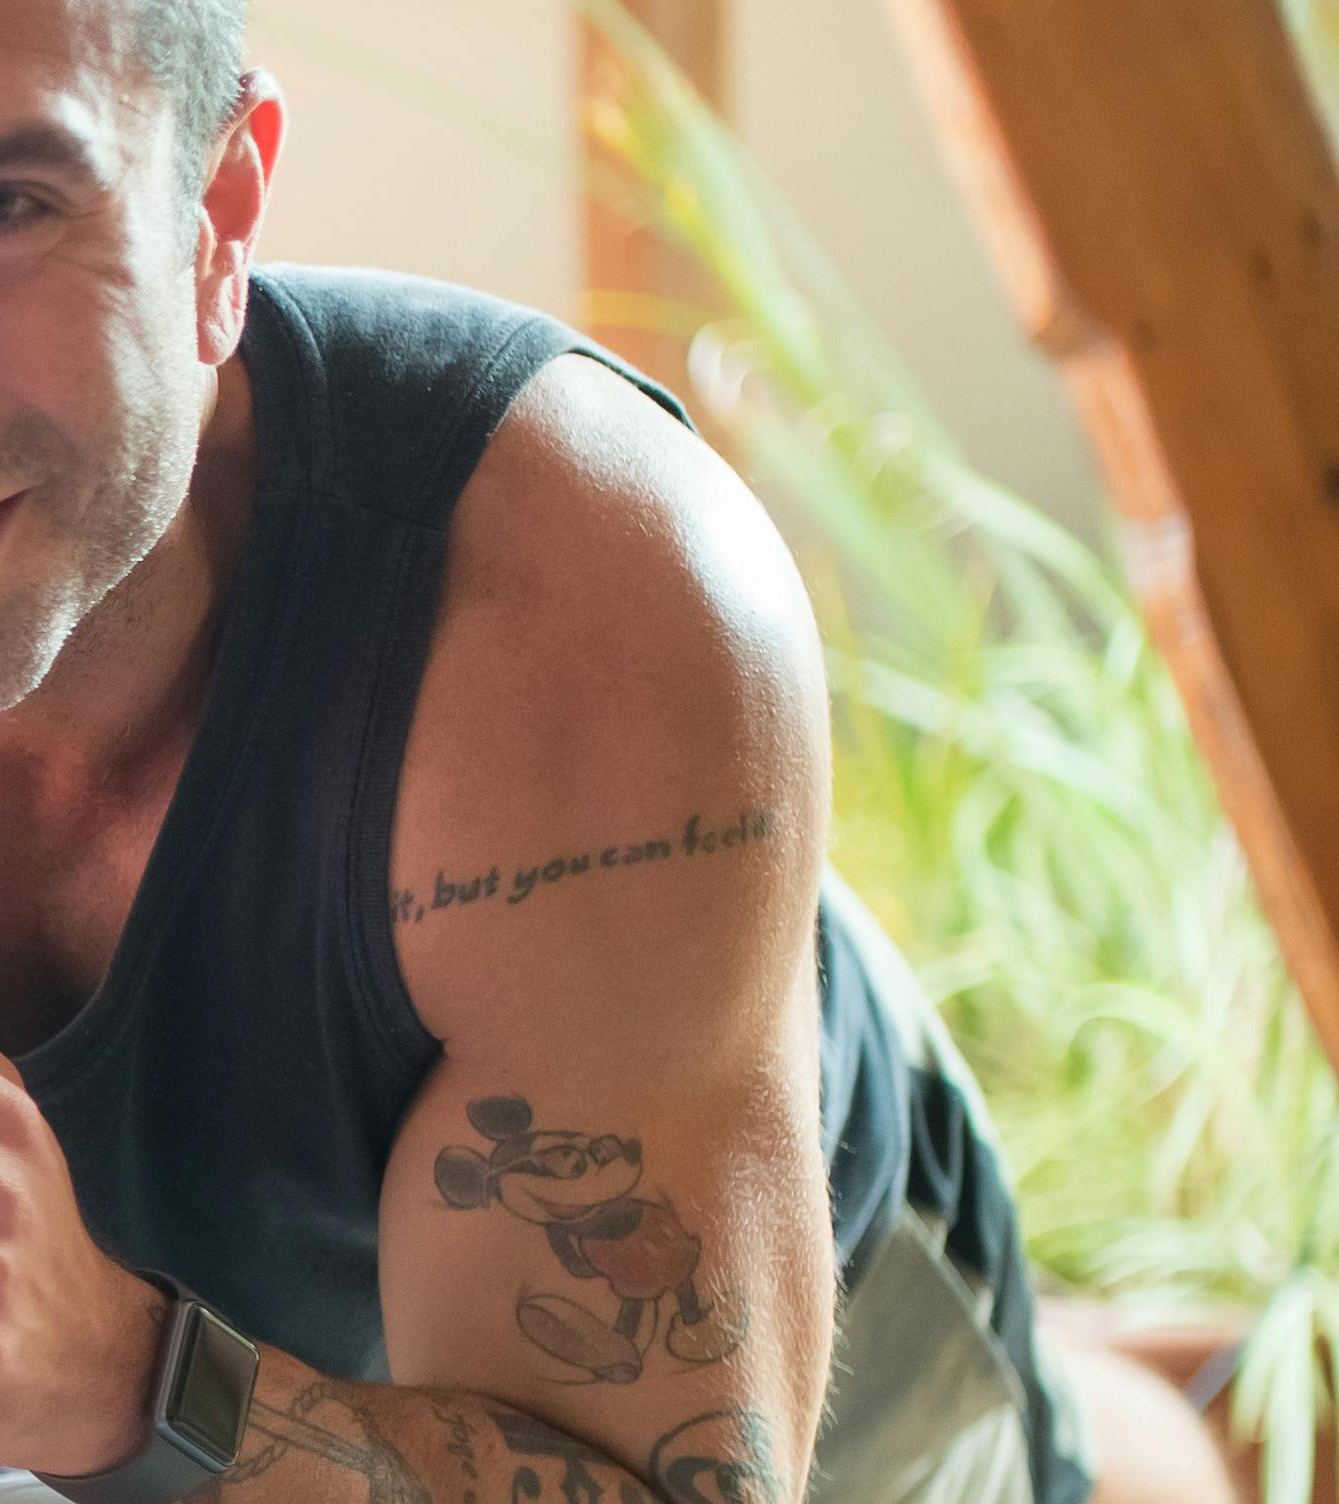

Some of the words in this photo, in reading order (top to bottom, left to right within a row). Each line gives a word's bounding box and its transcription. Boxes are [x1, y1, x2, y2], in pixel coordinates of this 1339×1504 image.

[431, 866, 500, 910] but
[507, 854, 589, 905] you
[599, 840, 671, 867] can
